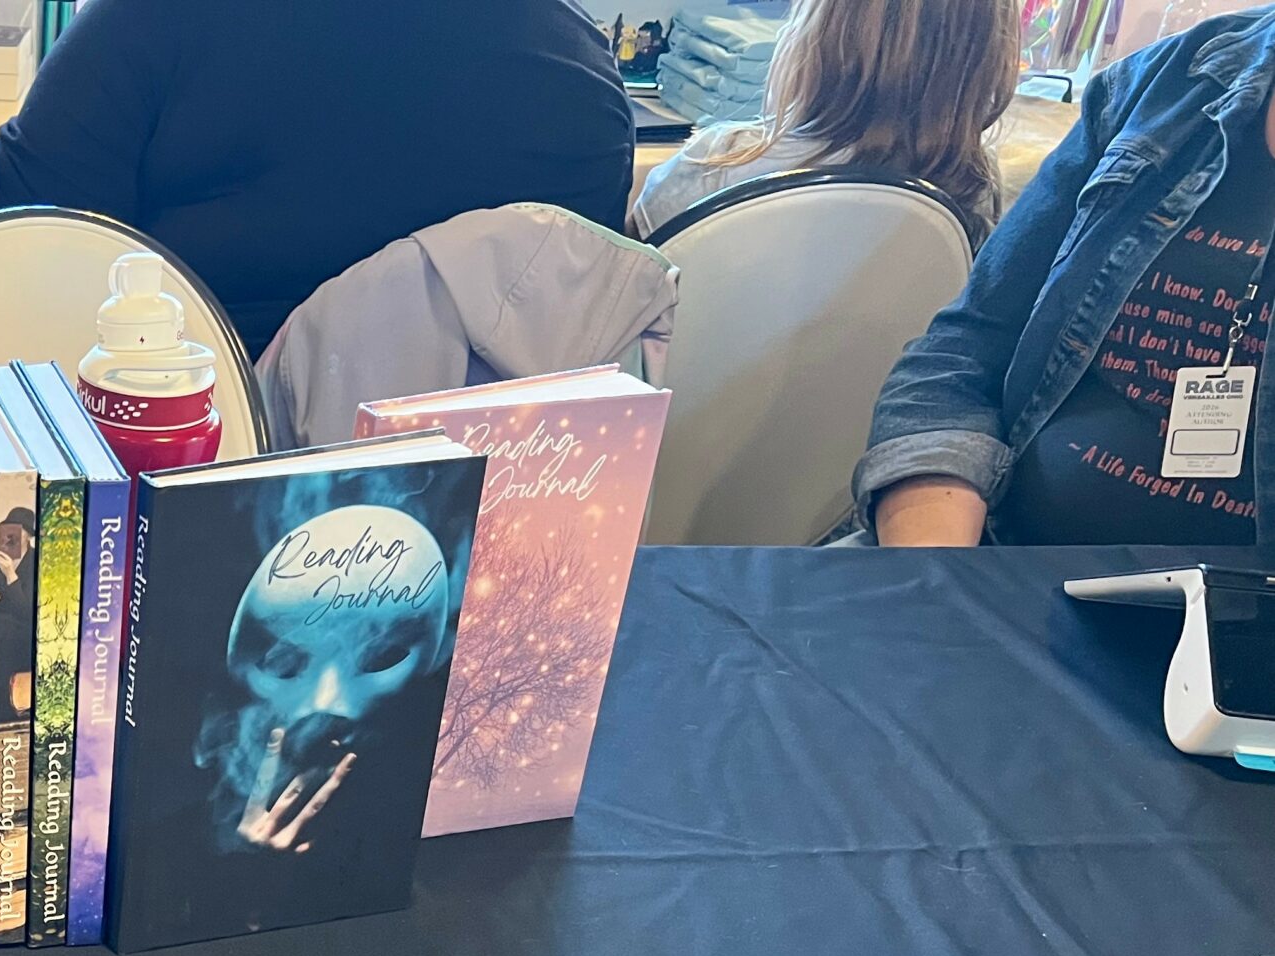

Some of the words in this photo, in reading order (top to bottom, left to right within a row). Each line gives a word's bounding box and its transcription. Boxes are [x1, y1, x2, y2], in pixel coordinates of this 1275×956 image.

[1185, 226, 1204, 242] do
[1208, 231, 1244, 251] have
[1164, 275, 1205, 302] know.
[1156, 310, 1192, 329] mine
[1199, 321, 1222, 337] are
[1186, 340, 1221, 363] have
[1101, 352, 1139, 373] them.
[1127, 383, 1141, 399] to
[1185, 380, 1244, 393] RAGE
[458, 418, 582, 471] Reading
[1081, 445, 1098, 464] A
[1097, 451, 1125, 477] Life
[1128, 466, 1185, 496] Forged
[1186, 484, 1205, 504] In
[479, 453, 608, 516] Journal
[88, 516, 123, 623] Reading
[129, 515, 149, 623] Reading
[266, 525, 413, 586] Reading
[305, 561, 443, 626] Journal
[90, 629, 114, 726] Journal
[125, 631, 141, 728] Journal
[39, 740, 69, 835] Reading
[43, 840, 66, 923] Journal
